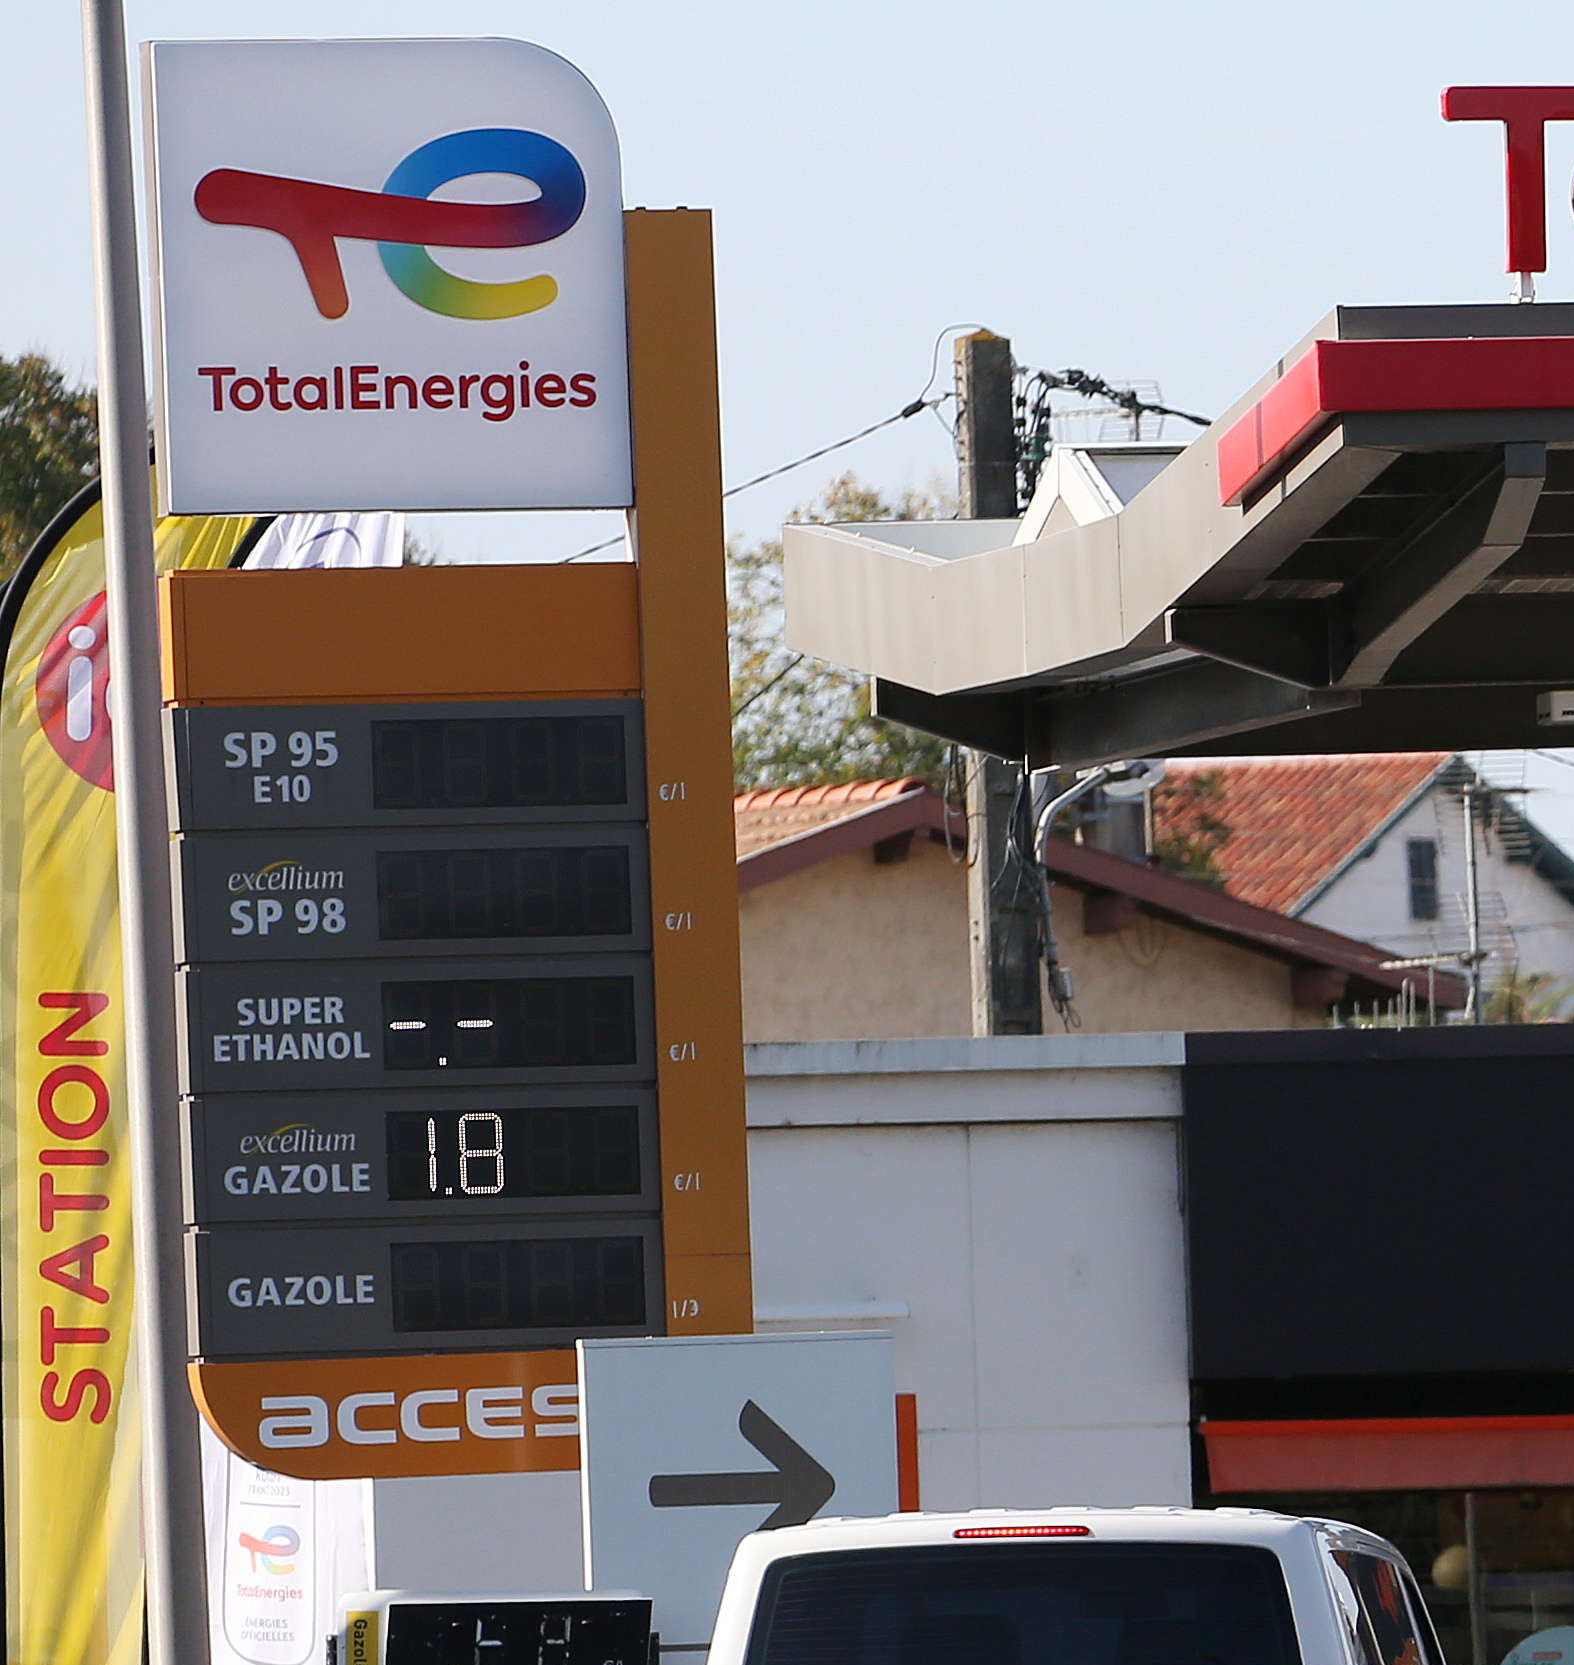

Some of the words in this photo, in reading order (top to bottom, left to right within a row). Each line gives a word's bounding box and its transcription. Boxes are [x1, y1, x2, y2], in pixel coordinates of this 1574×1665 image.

[198, 361, 597, 422] TotalEnergies
[223, 732, 277, 768] SP
[288, 731, 339, 767] 95
[253, 774, 312, 803] E10
[228, 866, 345, 892] excellium
[230, 900, 283, 935] SP
[295, 898, 347, 934] 98
[237, 997, 345, 1026] SUPER
[213, 1031, 371, 1063] ETHANOL
[240, 1129, 356, 1155] excellium
[427, 1111, 505, 1196] 1.8
[223, 1163, 371, 1195] GAZOLE
[38, 992, 112, 1424] STATION
[227, 1274, 375, 1307] GAZOLE
[237, 1584, 303, 1602] TotalEnergies
[240, 1629, 295, 1642] OFFICIELLES
